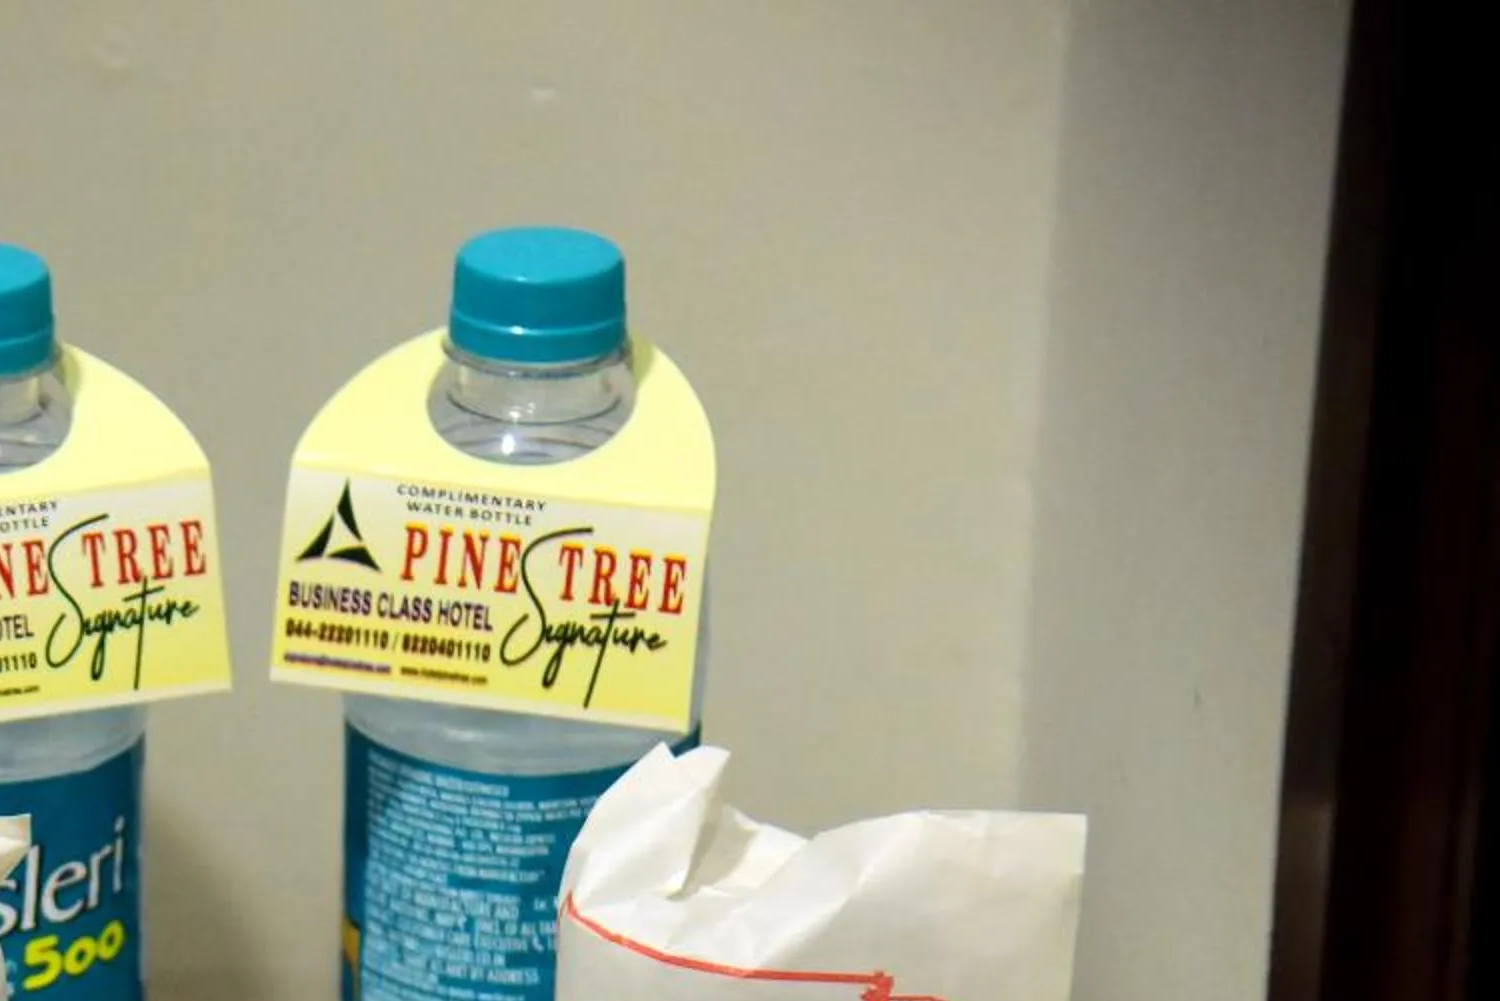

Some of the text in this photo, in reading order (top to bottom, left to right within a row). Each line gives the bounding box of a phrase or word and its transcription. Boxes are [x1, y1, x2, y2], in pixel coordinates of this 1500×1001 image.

[397, 484, 547, 512] COMPLIMENTARY
[407, 501, 533, 526] WATER BOTTLE
[82, 520, 207, 589] TREE
[400, 522, 687, 615] PINE TREE
[45, 514, 198, 690] Signature
[286, 618, 389, 650] 044-22201110
[289, 581, 493, 632] BUSINESS CLASS HOTEL
[500, 527, 668, 709] Signature
[22, 921, 125, 991] 500
